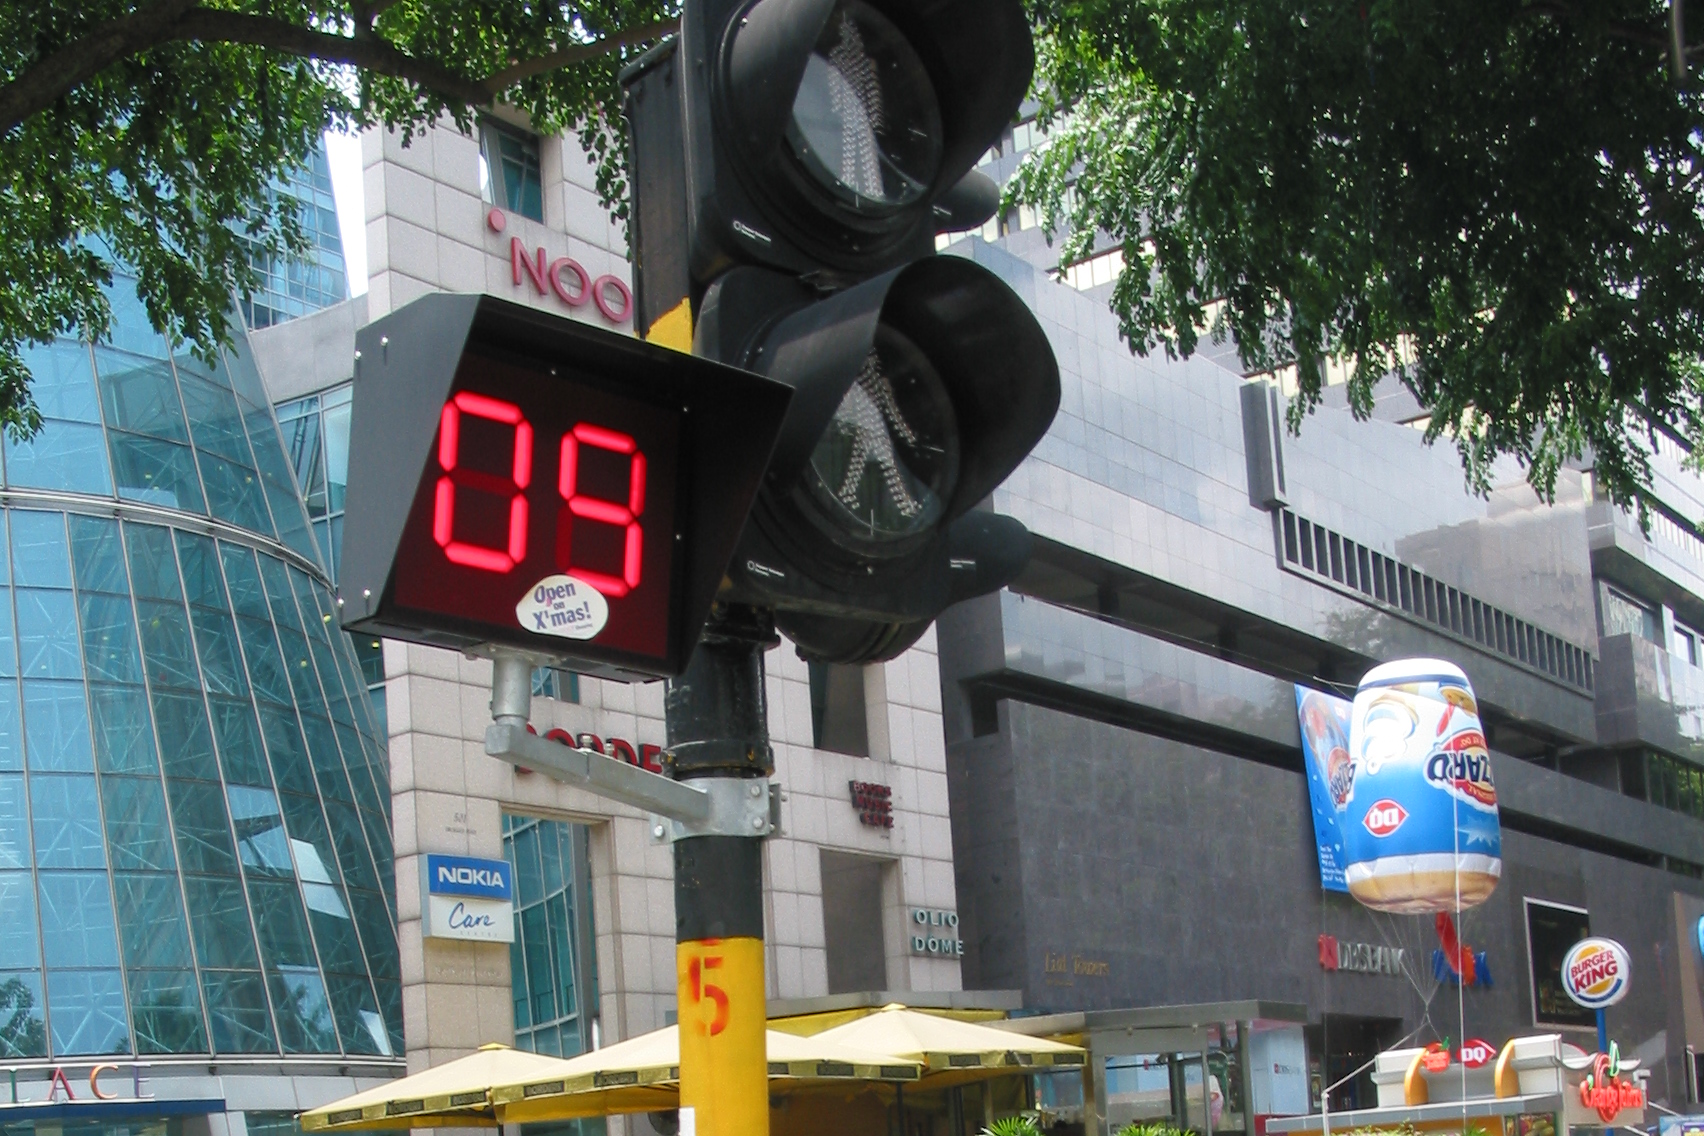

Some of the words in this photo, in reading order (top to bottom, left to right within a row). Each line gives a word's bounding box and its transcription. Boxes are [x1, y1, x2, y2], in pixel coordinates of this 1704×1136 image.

[433, 388, 647, 598] 09
[533, 583, 576, 607] Open
[533, 601, 592, 630] X'mas!
[1427, 752, 1495, 786] ZARD
[1369, 807, 1399, 829] DQ
[438, 866, 505, 889] NOKIA
[448, 901, 496, 930] Care
[914, 909, 959, 928] OLIO
[1571, 950, 1614, 978] BURGER
[1574, 960, 1618, 993] KING
[689, 954, 730, 1037] 5
[1461, 1046, 1486, 1063] DQ
[9, 1064, 156, 1104] LACE
